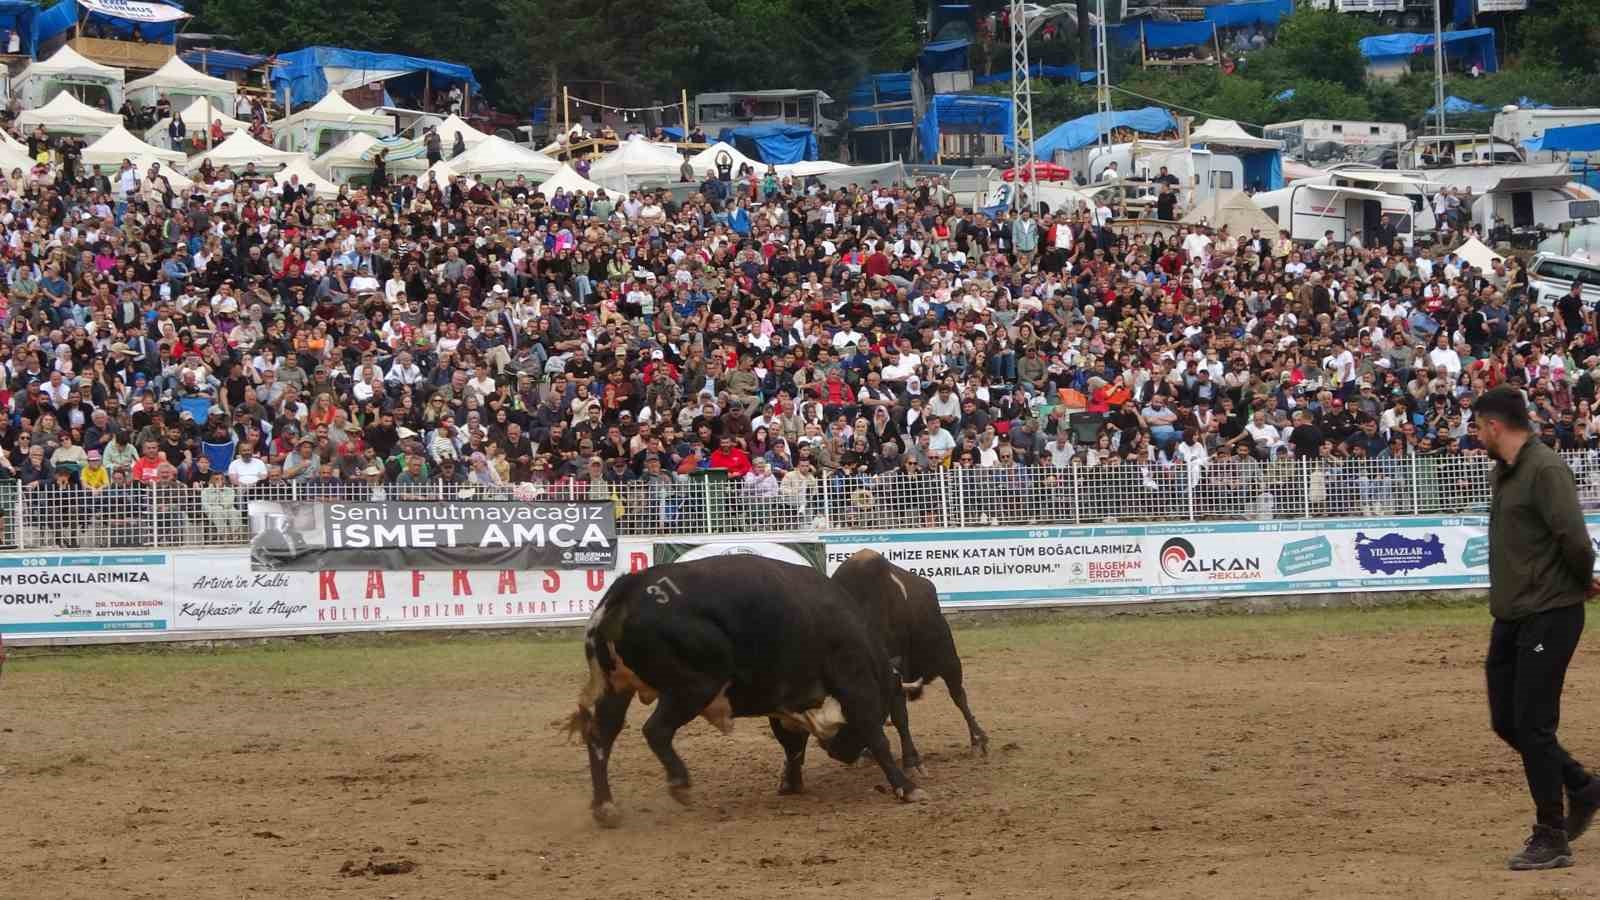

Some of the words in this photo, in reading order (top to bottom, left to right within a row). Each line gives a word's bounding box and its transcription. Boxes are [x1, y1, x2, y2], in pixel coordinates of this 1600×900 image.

[330, 503, 388, 521] Seni
[398, 503, 604, 524] unutmayacağız
[479, 523, 611, 548] AMCA
[926, 549, 960, 560] RENK
[963, 547, 1006, 559] KATAN
[1009, 545, 1035, 557] TÜM
[1039, 543, 1142, 556] BOĞACILARIMIZA
[909, 566, 980, 578] BAŞARILAR
[1182, 557, 1260, 572] ALKAN
[17, 571, 150, 585] BOĞACILARIMIZA
[192, 575, 249, 590] Artvin'in
[251, 573, 291, 588] Kalbi
[1088, 570, 1126, 579] ERDEM
[1208, 571, 1263, 580] REKLAM
[646, 576, 682, 604] 37
[179, 603, 243, 621] Kafkasör
[401, 603, 465, 619] TURİZM
[477, 603, 494, 616] VE
[506, 600, 557, 615] SANAT
